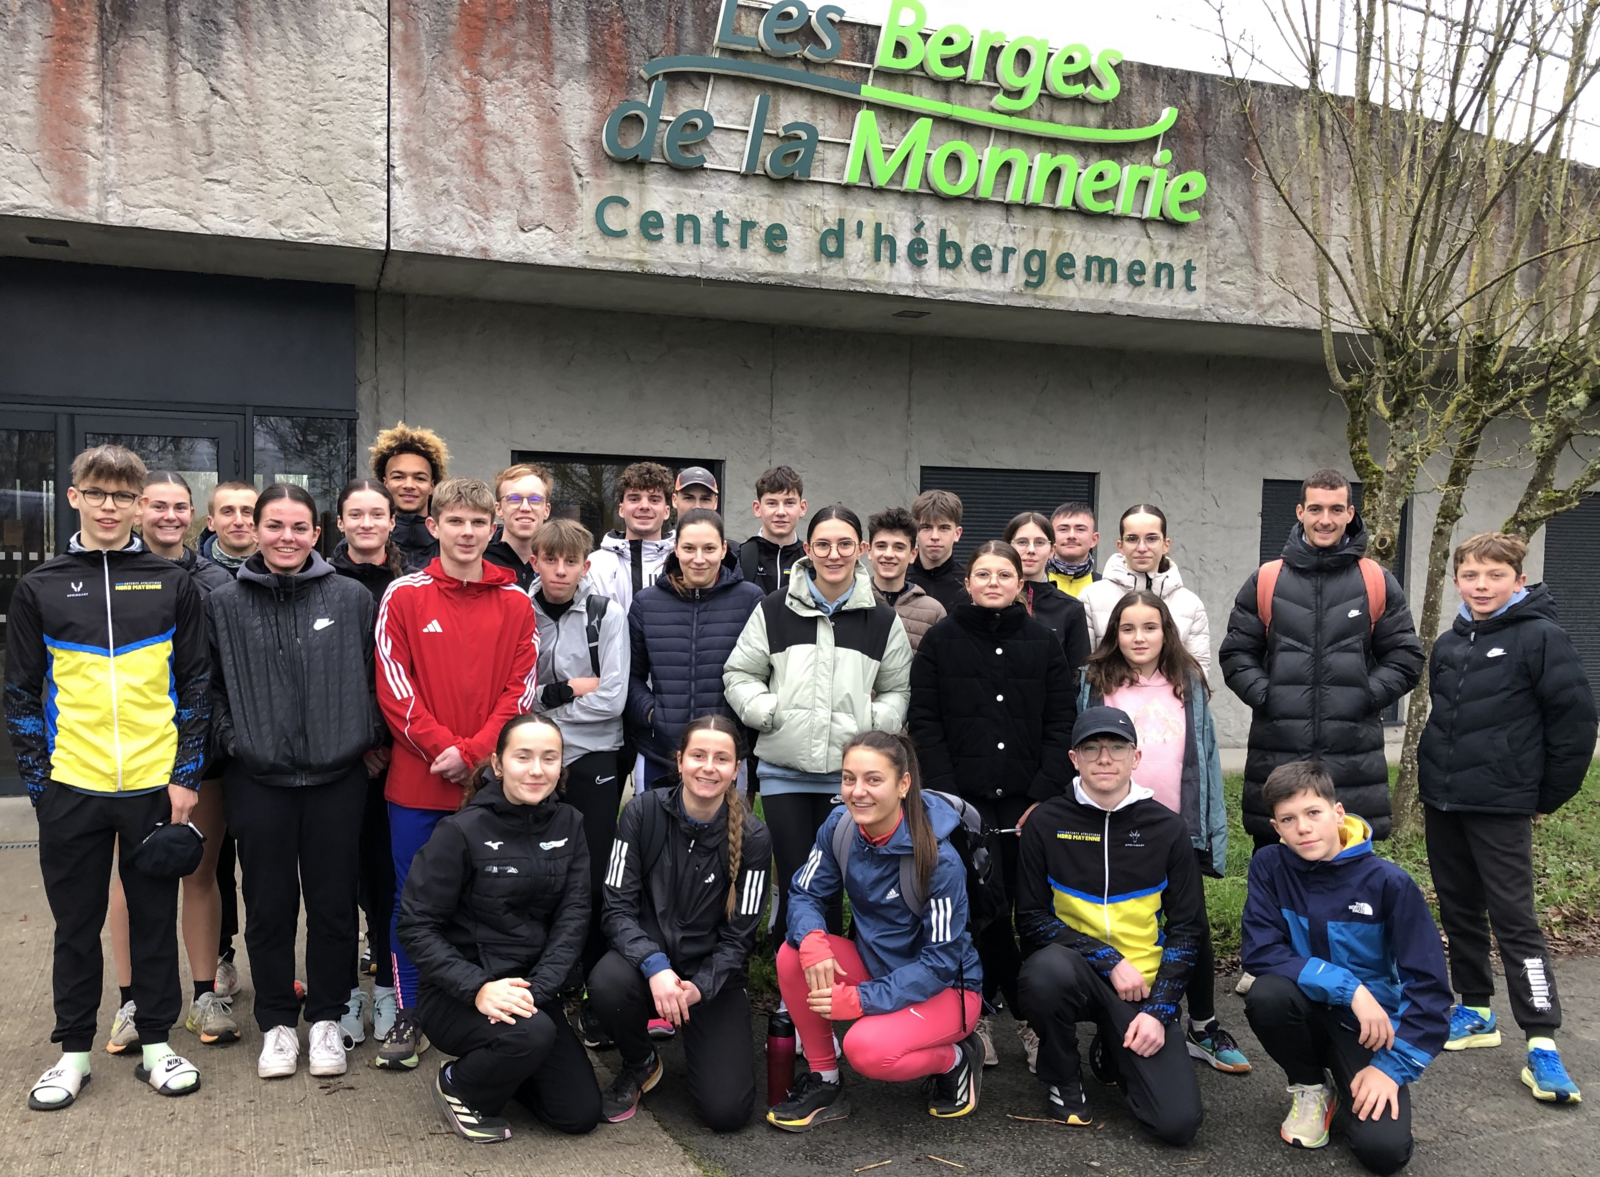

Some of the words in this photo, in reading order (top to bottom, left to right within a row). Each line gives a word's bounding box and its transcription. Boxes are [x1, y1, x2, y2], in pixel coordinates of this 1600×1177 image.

[715, 0, 846, 63] Les
[874, 0, 1123, 112] Berges
[602, 80, 714, 169] de
[740, 93, 819, 180] la
[843, 110, 1207, 224] Monnerie
[595, 195, 789, 253] Centre
[819, 216, 1198, 292] d'hébergement
